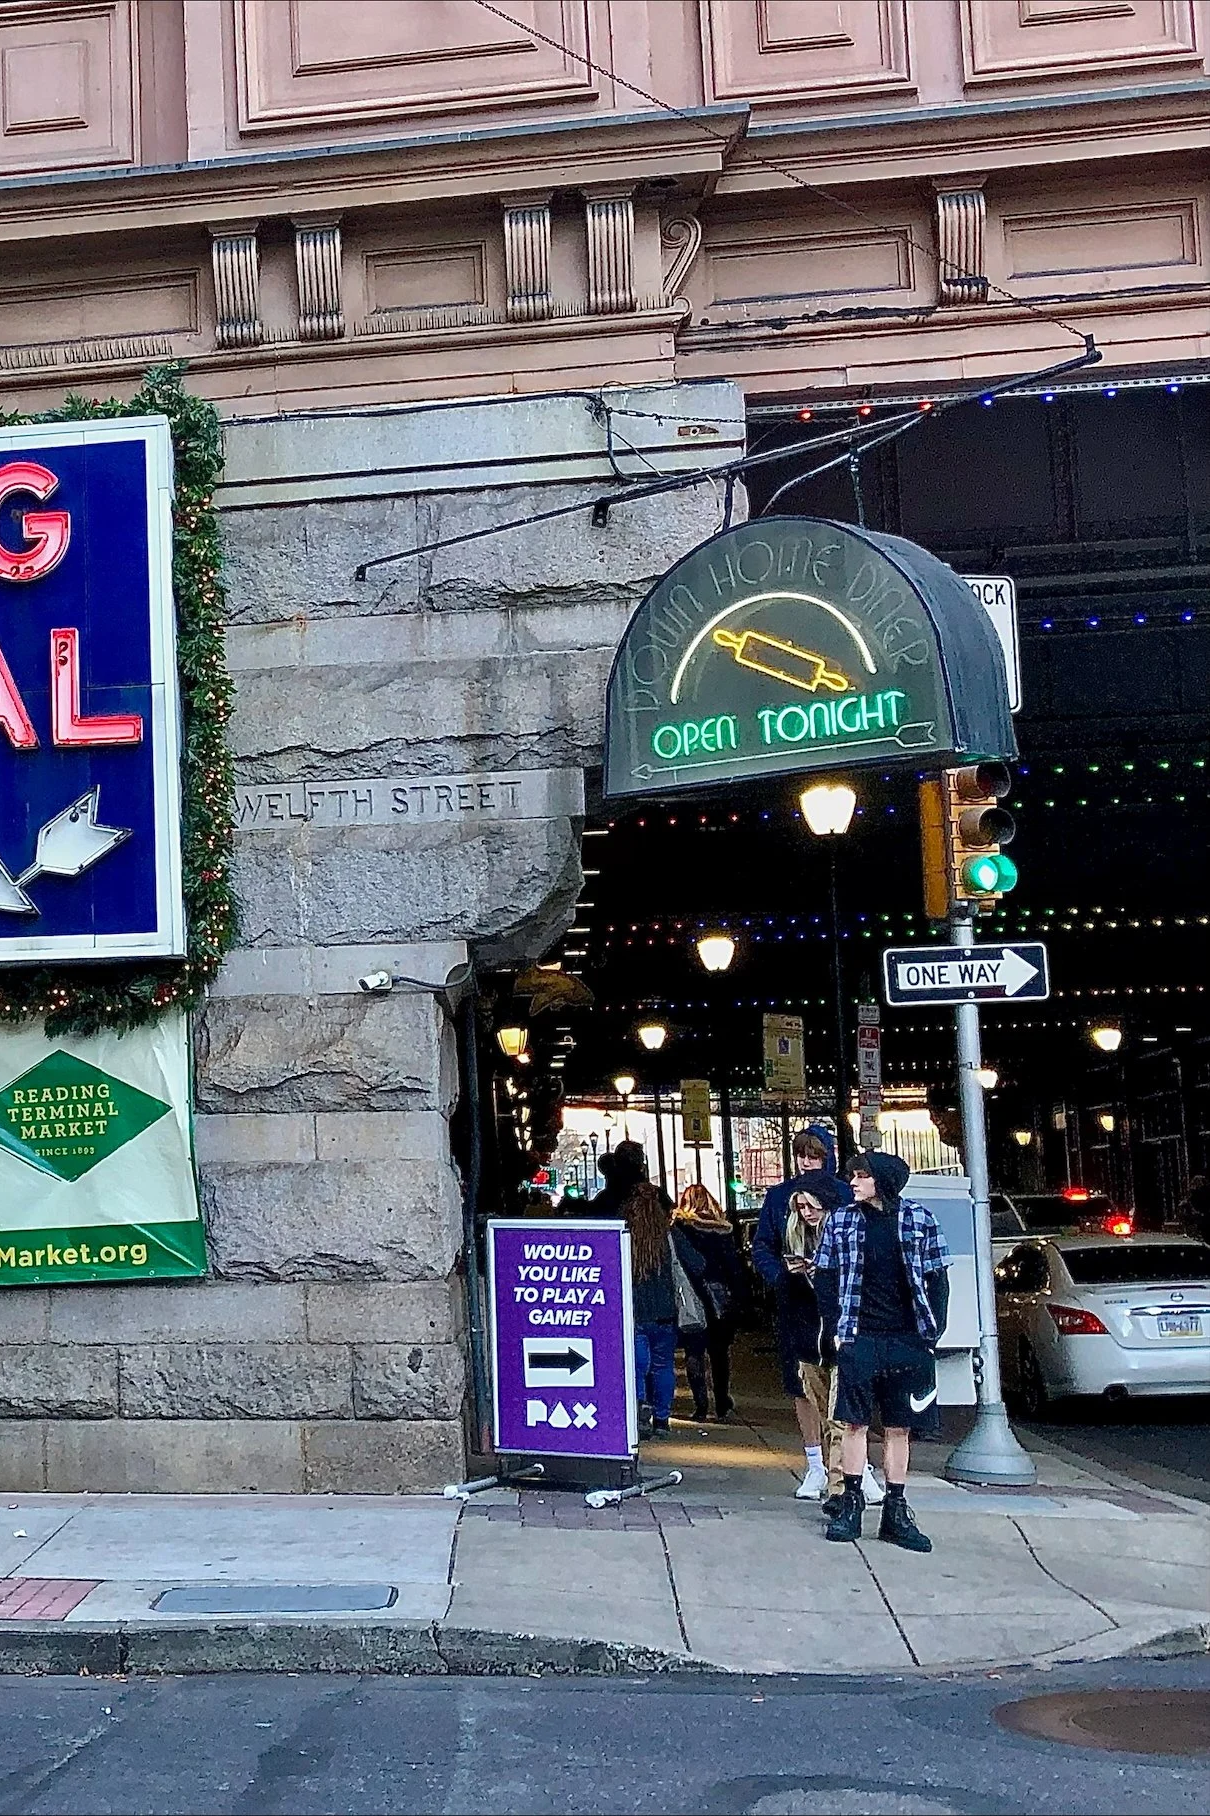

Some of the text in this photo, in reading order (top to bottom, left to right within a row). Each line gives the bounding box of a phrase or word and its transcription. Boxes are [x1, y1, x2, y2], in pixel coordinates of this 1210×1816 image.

[971, 583, 1006, 605] OCK
[626, 537, 929, 712] DOWN HOME DINER
[653, 690, 906, 759] OPEN TONIGHT
[232, 781, 522, 823] WELFTH STREET
[906, 962, 1002, 987] ONE WAY
[13, 1083, 110, 1104] READING
[7, 1101, 119, 1122] TERMINAL
[20, 1120, 108, 1140] MARKET
[35, 1146, 95, 1157] SINCE 1893
[523, 1244, 593, 1261] WOULD
[517, 1265, 602, 1283] YOU LIKE
[513, 1287, 605, 1305] TO PLAY A
[528, 1309, 593, 1326] GAME?
[526, 1399, 598, 1430] PAX
